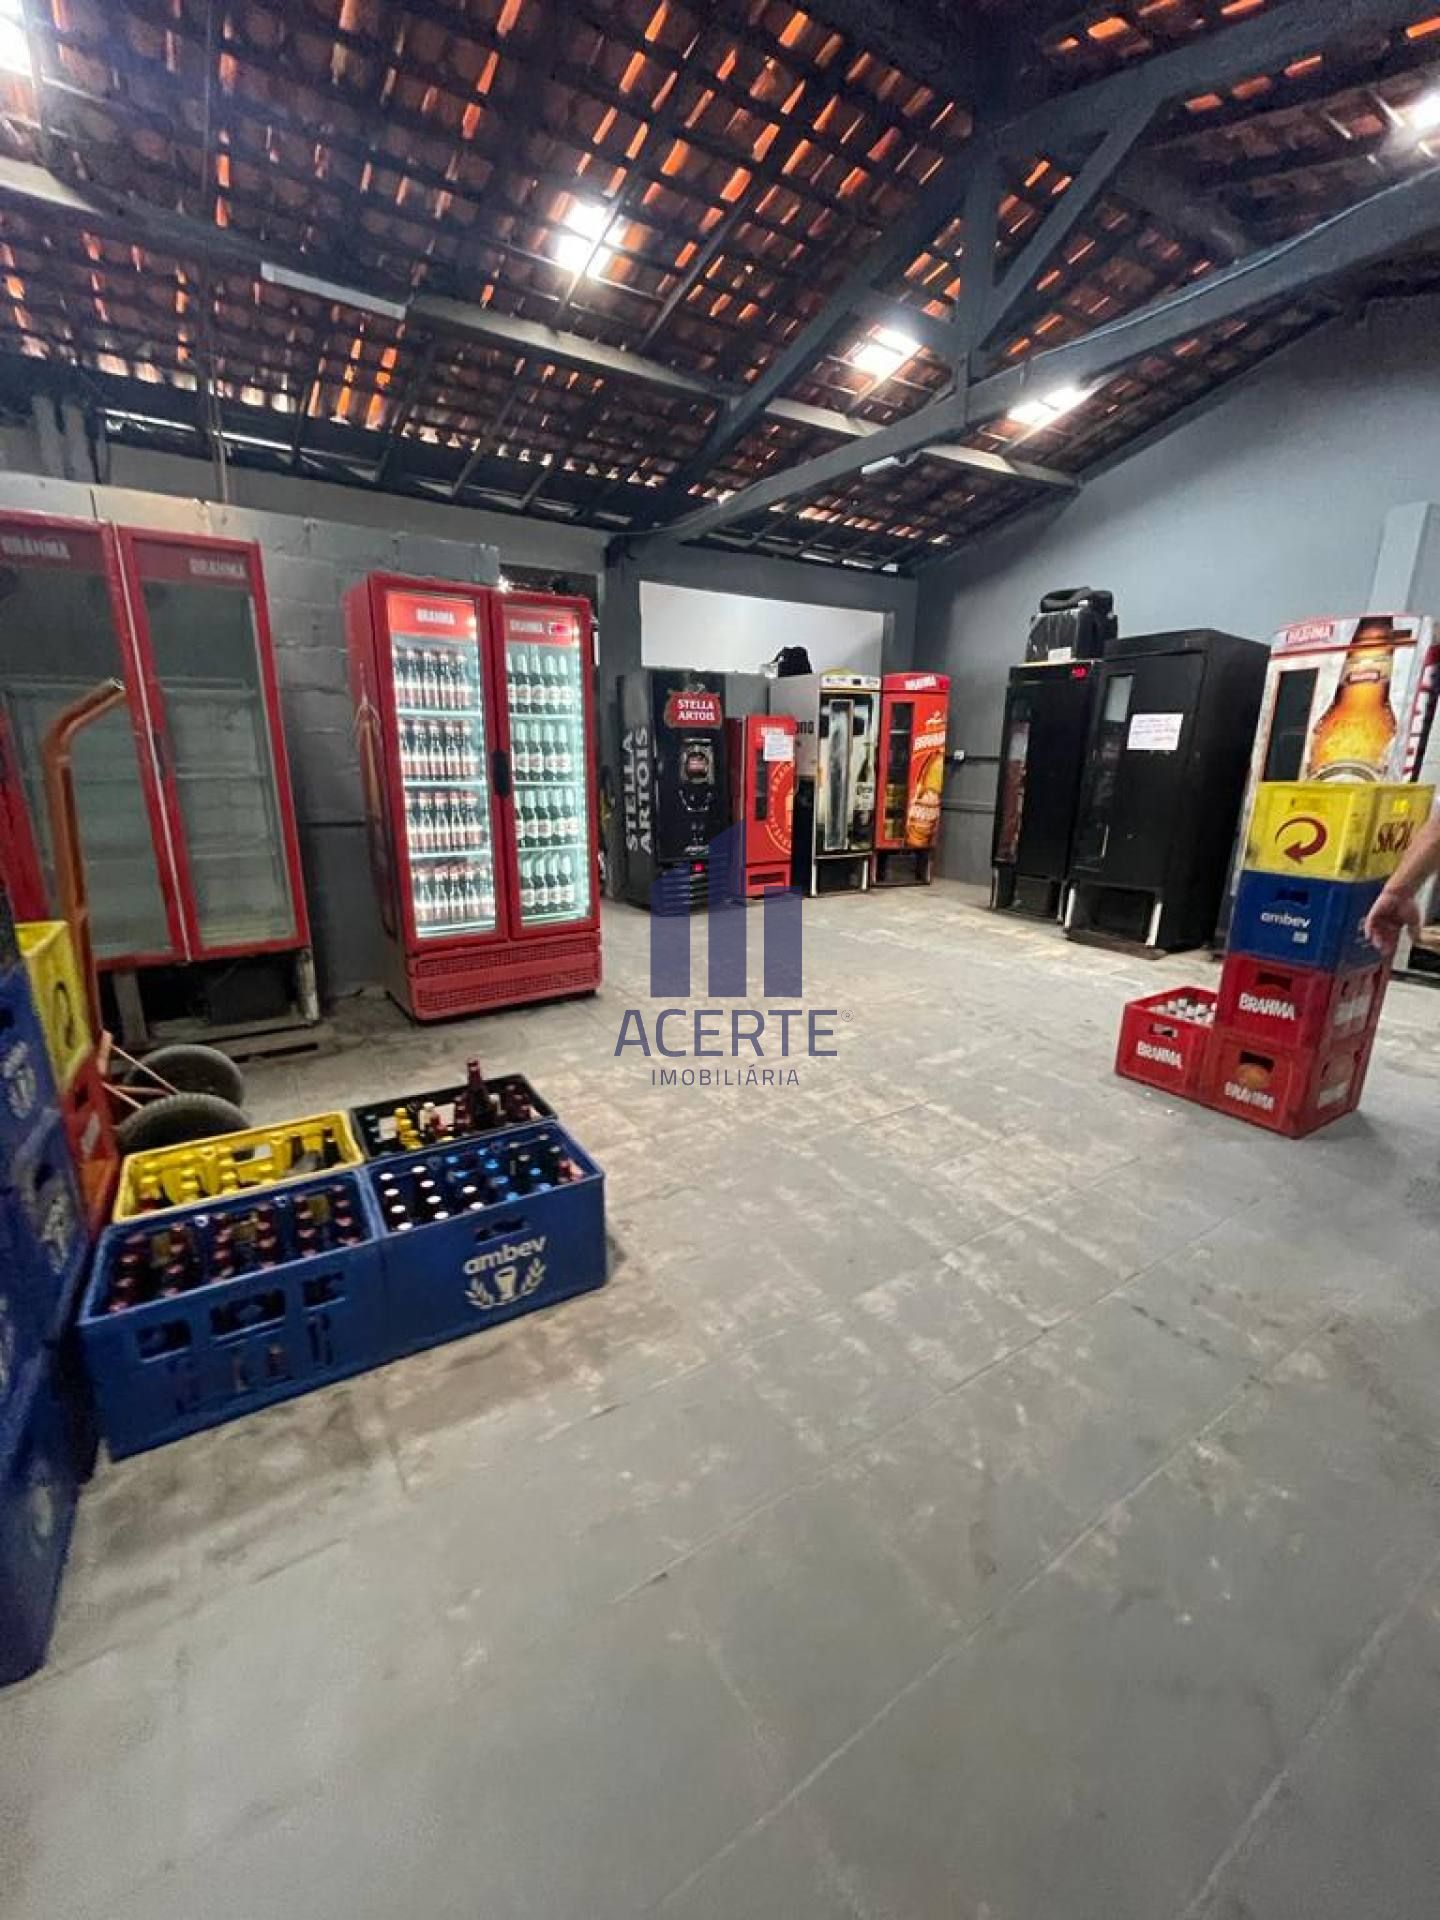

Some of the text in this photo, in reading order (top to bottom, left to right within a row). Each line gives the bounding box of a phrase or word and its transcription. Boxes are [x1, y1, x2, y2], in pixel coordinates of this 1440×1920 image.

[677, 699, 714, 710] STELLA
[677, 710, 715, 721] ARTOIS
[622, 730, 638, 851] STELLA
[635, 726, 652, 855] ARTOIS
[1260, 908, 1311, 929] ambev
[1238, 992, 1296, 1020] BRAHMA
[1136, 1040, 1182, 1069] BRAHMA
[463, 1236, 547, 1275] ambev
